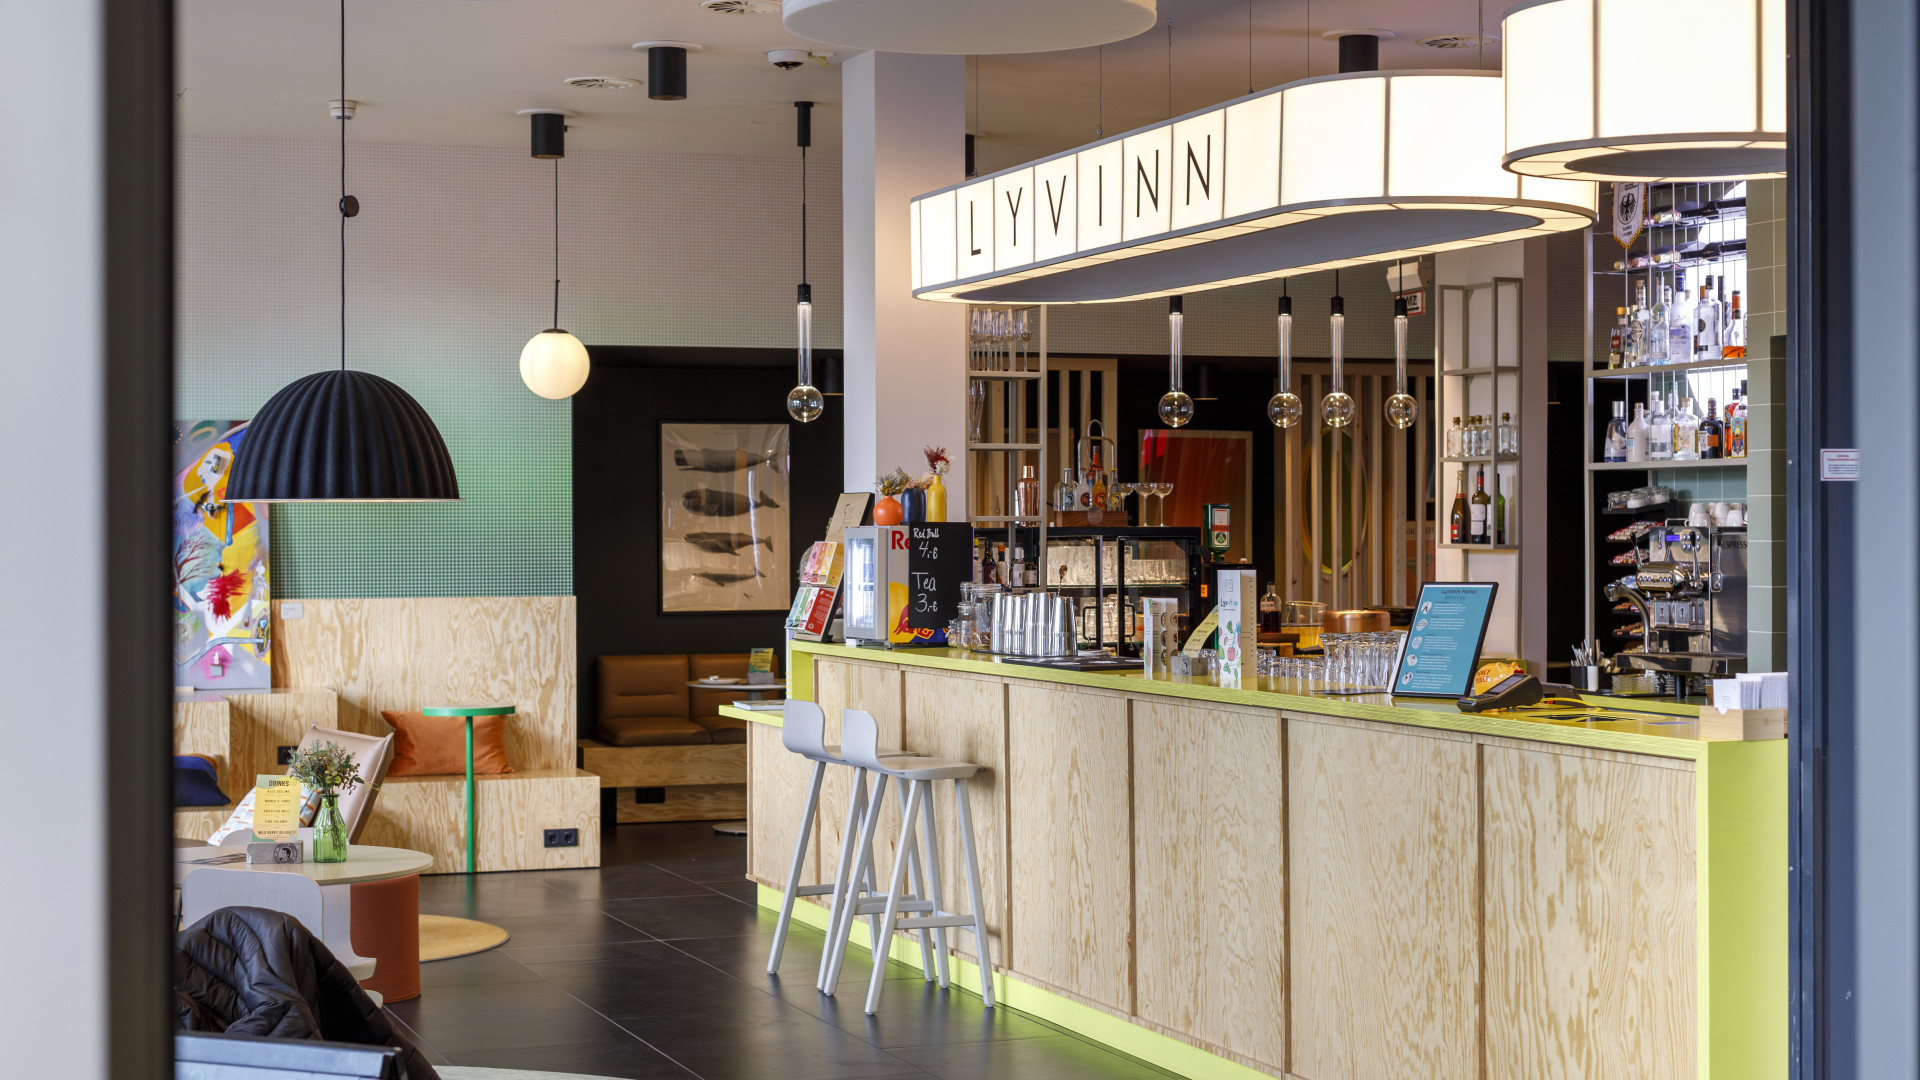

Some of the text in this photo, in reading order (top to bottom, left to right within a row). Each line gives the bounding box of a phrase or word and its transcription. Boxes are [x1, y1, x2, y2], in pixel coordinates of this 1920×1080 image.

[970, 133, 1212, 257] LYVINN
[1406, 295, 1418, 306] MZ
[913, 527, 940, 539] Red Bull
[911, 572, 937, 592] Tea
